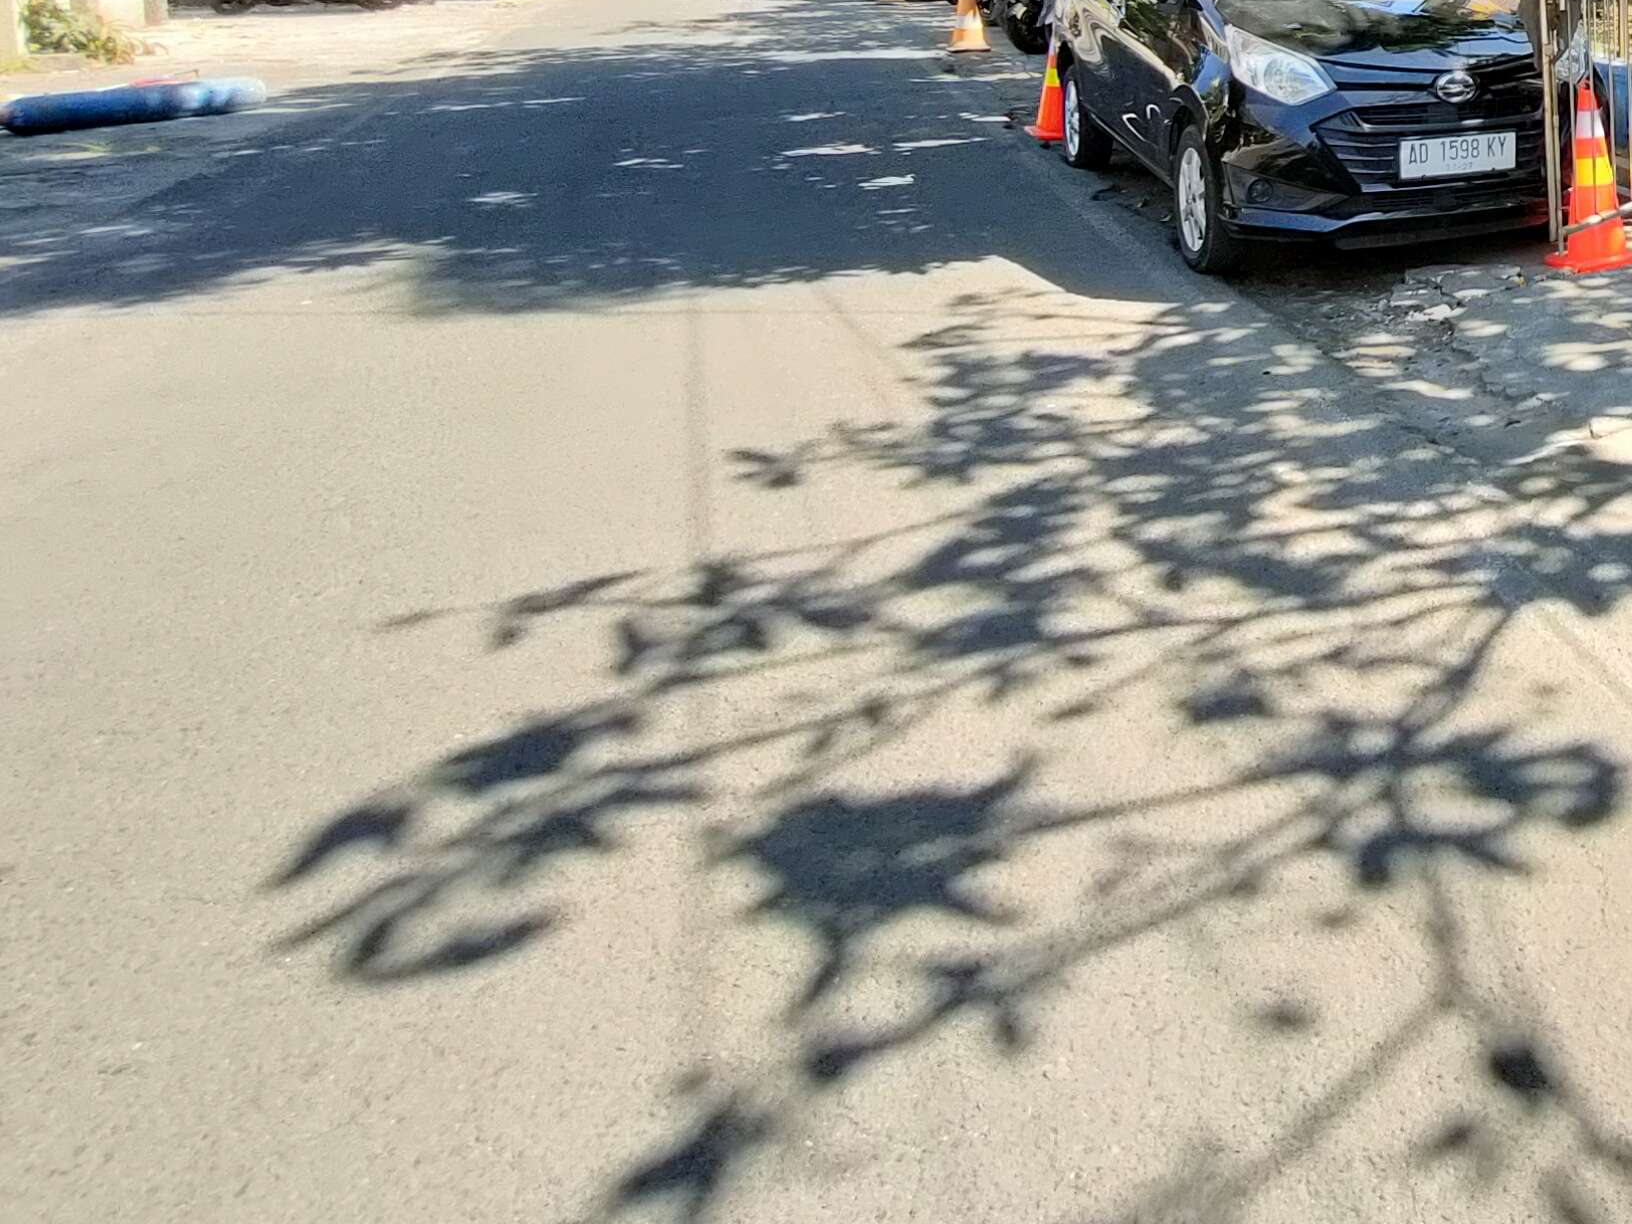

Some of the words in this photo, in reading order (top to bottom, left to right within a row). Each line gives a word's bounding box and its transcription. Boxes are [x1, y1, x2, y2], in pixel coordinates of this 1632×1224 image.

[1408, 142, 1429, 165] AD
[1440, 138, 1480, 162] 1598
[1487, 135, 1507, 158] KY
